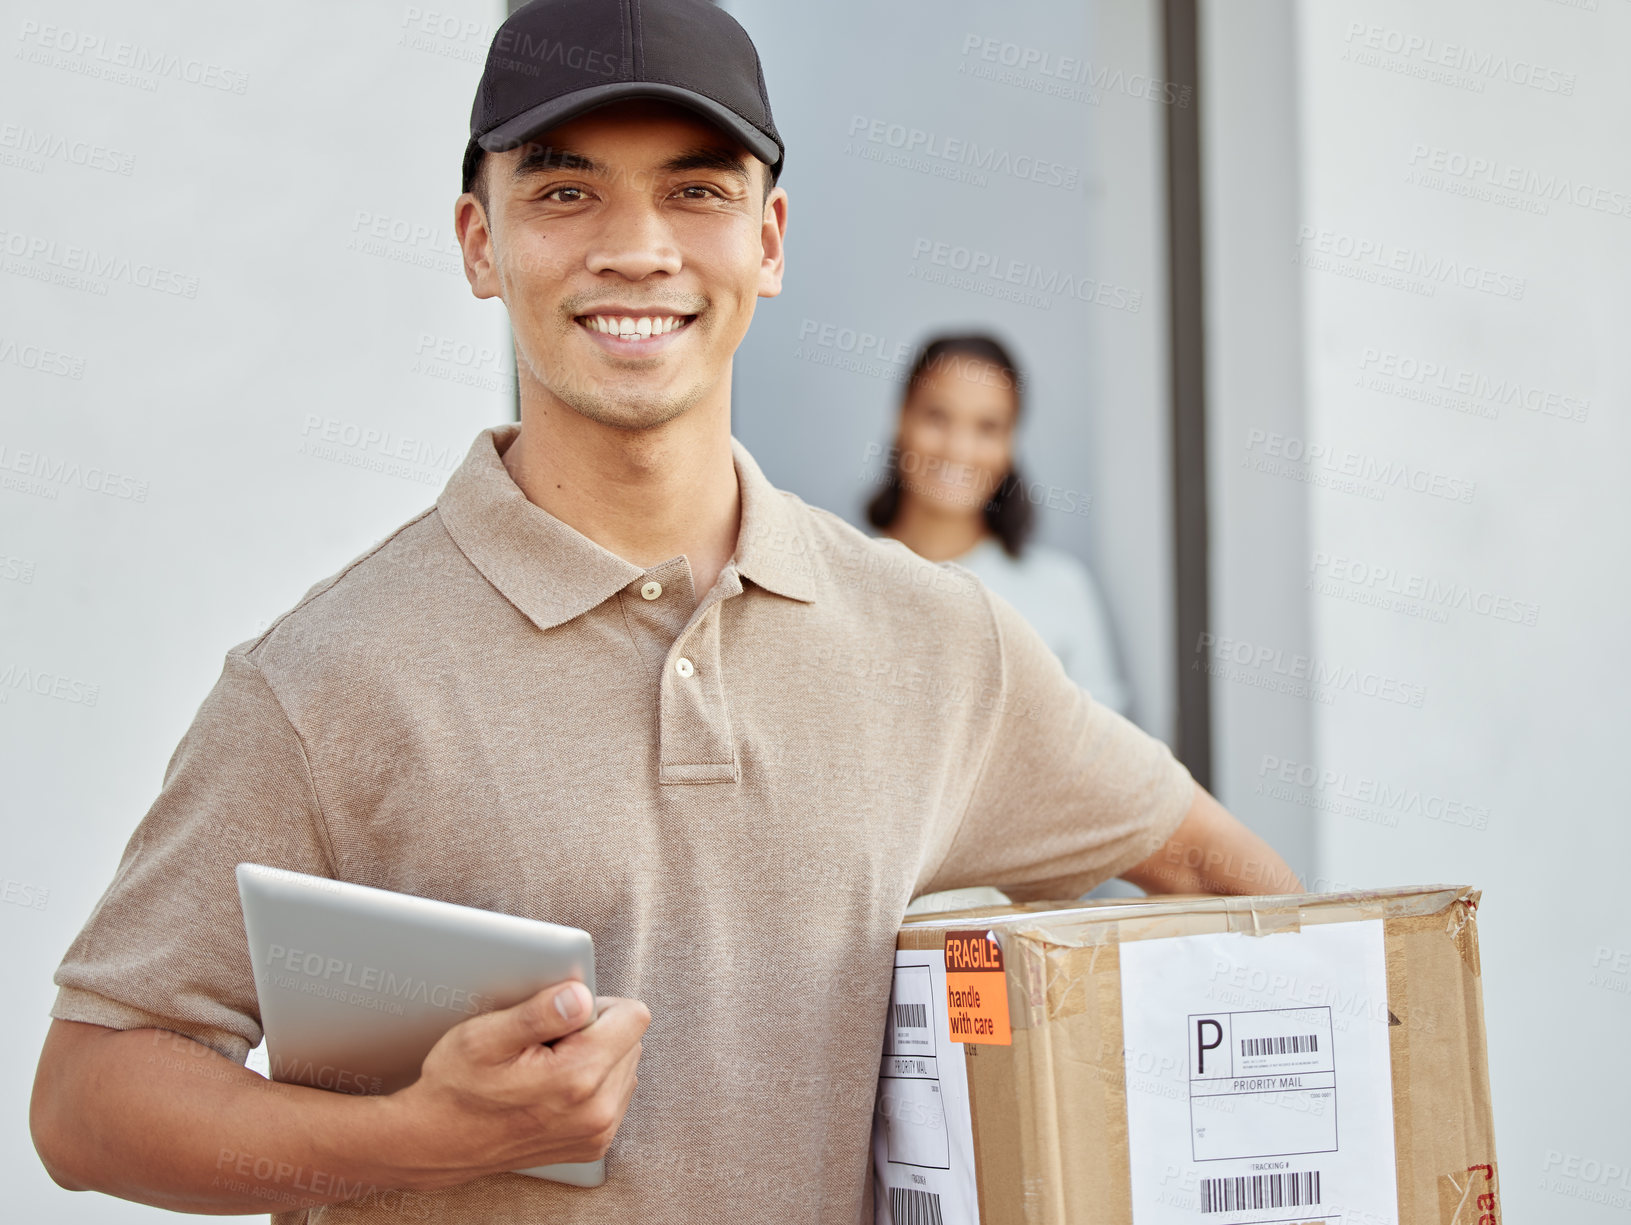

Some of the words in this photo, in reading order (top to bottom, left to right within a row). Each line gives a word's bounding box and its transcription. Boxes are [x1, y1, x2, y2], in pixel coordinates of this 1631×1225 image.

[945, 938, 1000, 969] FRAGILE
[949, 985, 981, 1009] handle
[950, 1011, 973, 1035] with
[974, 1017, 994, 1036] care
[1197, 1019, 1223, 1074] P
[1233, 1079, 1277, 1091] PRIORITY
[1279, 1077, 1303, 1088] MAIL
[1252, 1162, 1284, 1171] TRACKING
